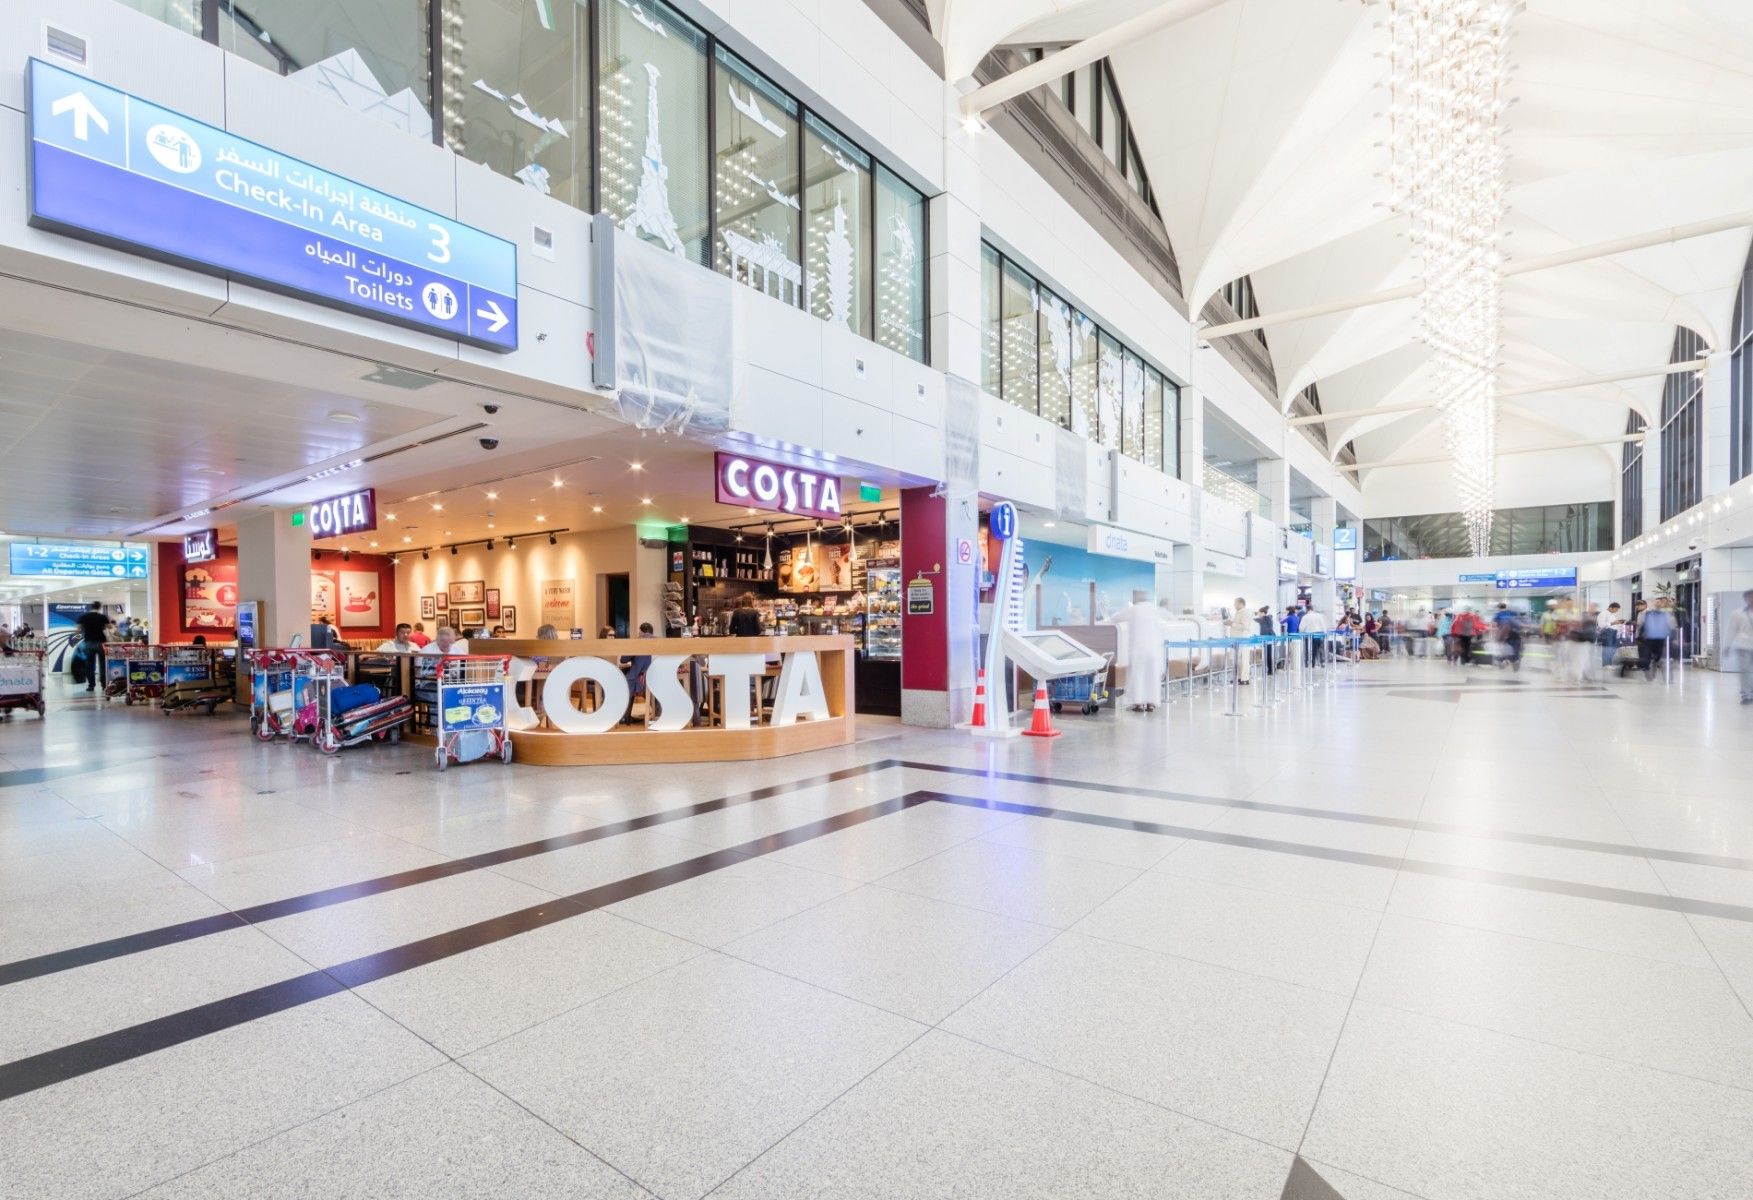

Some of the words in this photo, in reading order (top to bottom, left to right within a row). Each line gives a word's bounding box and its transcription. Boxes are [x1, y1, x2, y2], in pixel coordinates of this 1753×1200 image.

[215, 147, 280, 179] السفر
[215, 169, 324, 223] Check-In
[331, 210, 384, 243] Area
[285, 170, 354, 211] إجراءات
[359, 196, 417, 229] منطقة
[304, 240, 357, 270] المياه
[426, 222, 452, 264] 3
[361, 259, 414, 287] دورات
[344, 274, 415, 311] Toilets
[727, 458, 840, 513] COSTA
[309, 494, 367, 534] COSTA
[26, 546, 49, 558] 1-2
[1340, 528, 1351, 543] 2
